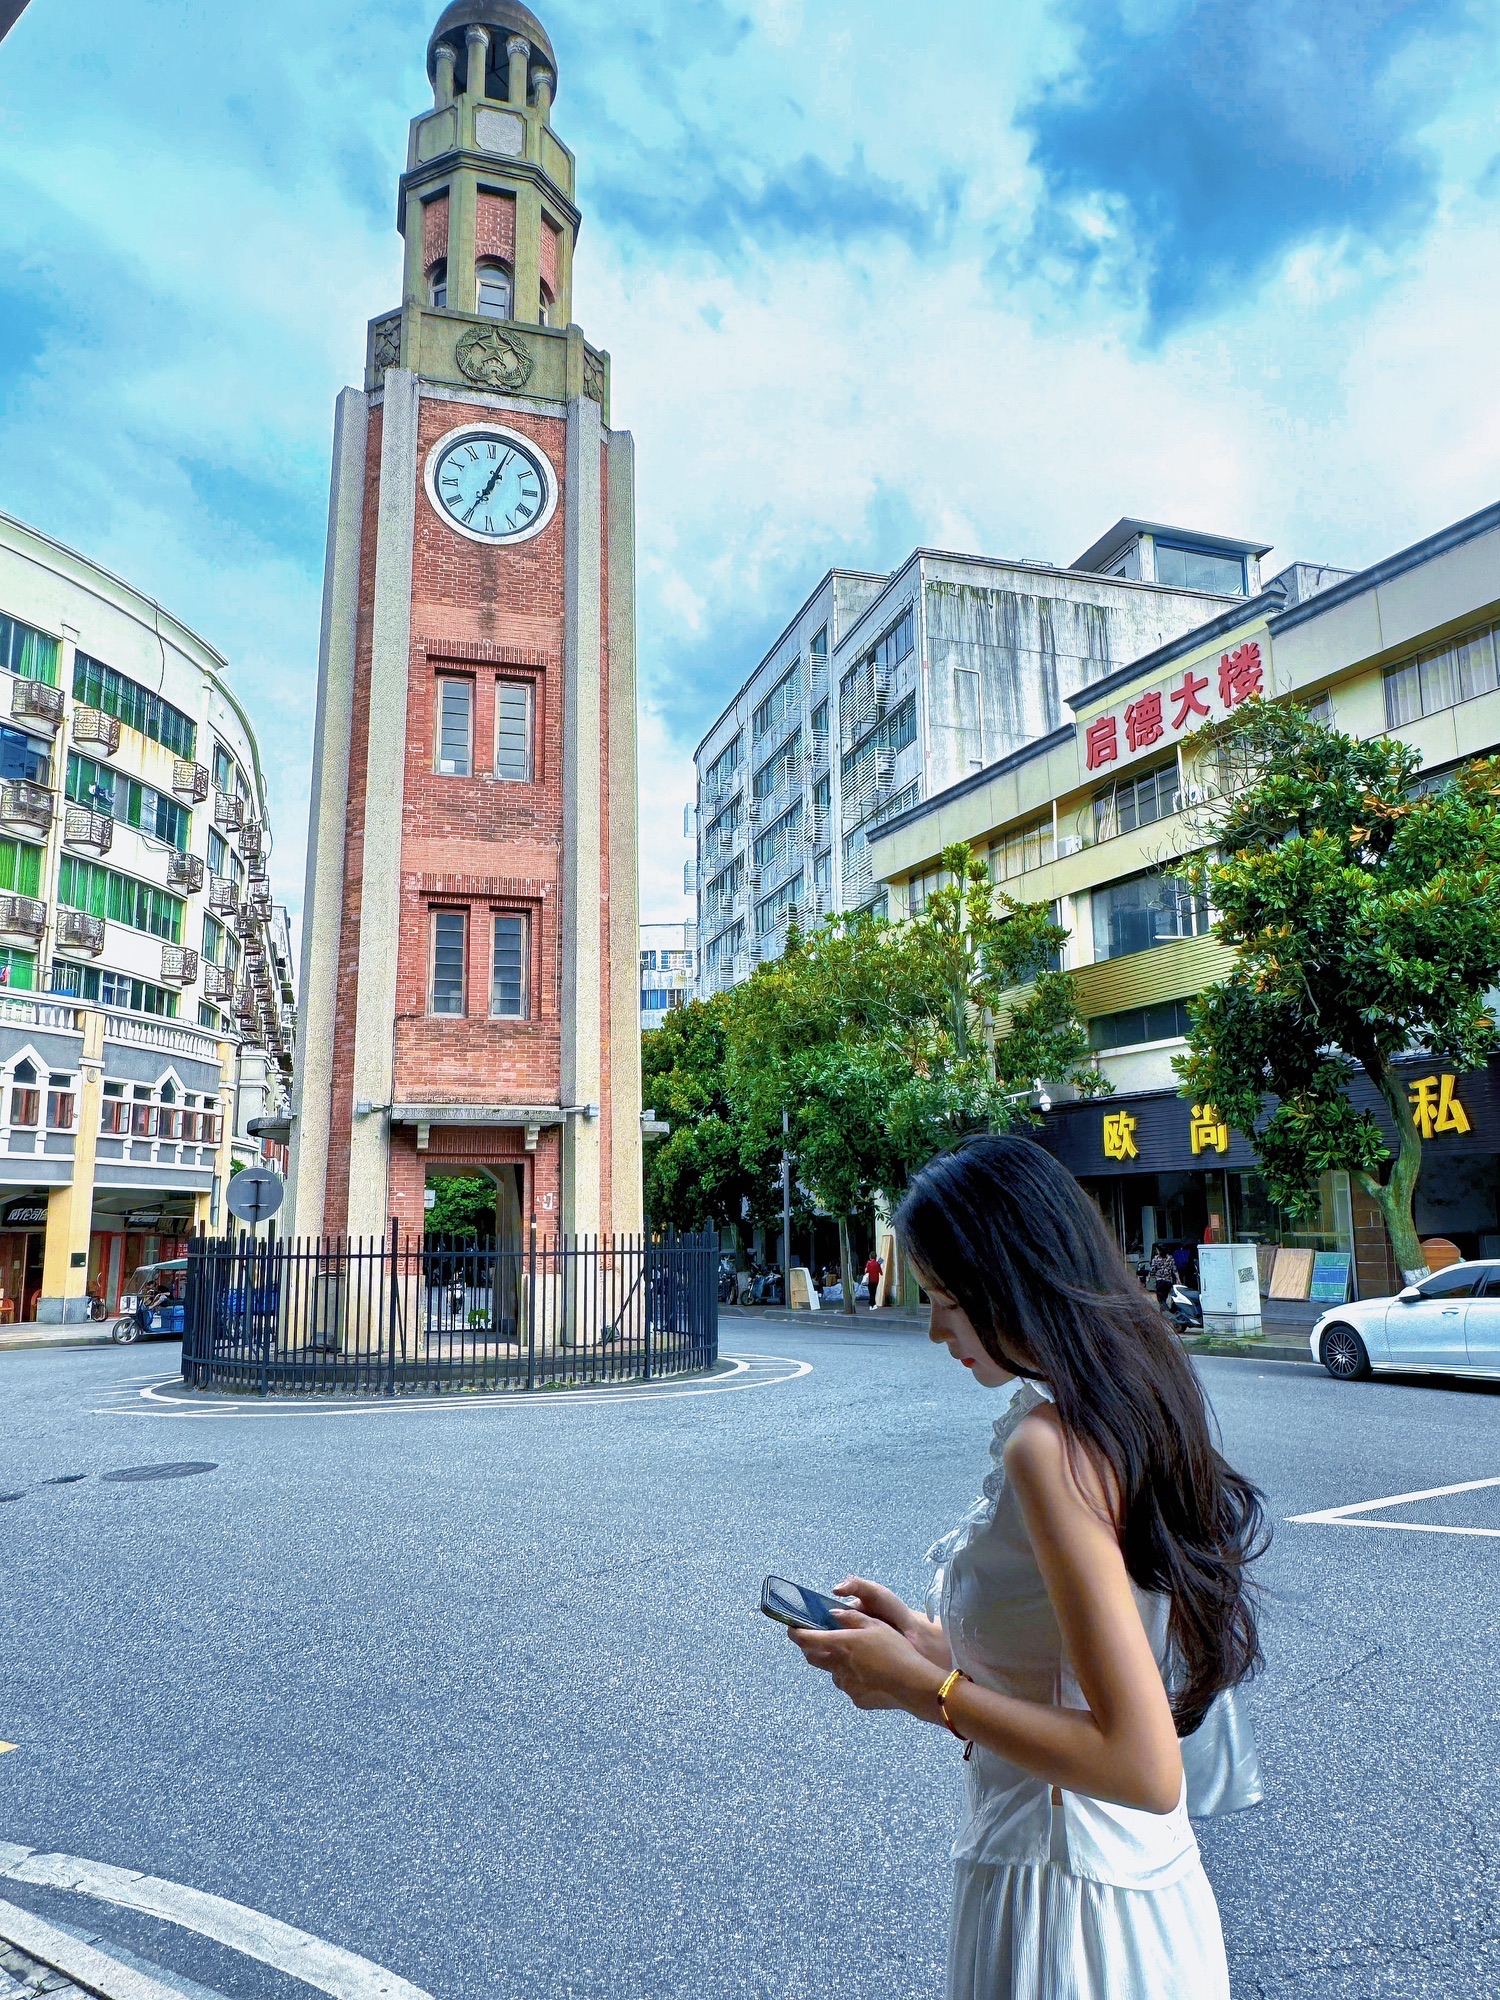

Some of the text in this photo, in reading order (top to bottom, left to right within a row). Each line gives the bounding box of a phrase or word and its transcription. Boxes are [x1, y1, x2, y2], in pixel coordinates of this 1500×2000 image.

[448, 456, 466, 472] X
[1085, 642, 1264, 771] 启德大楼
